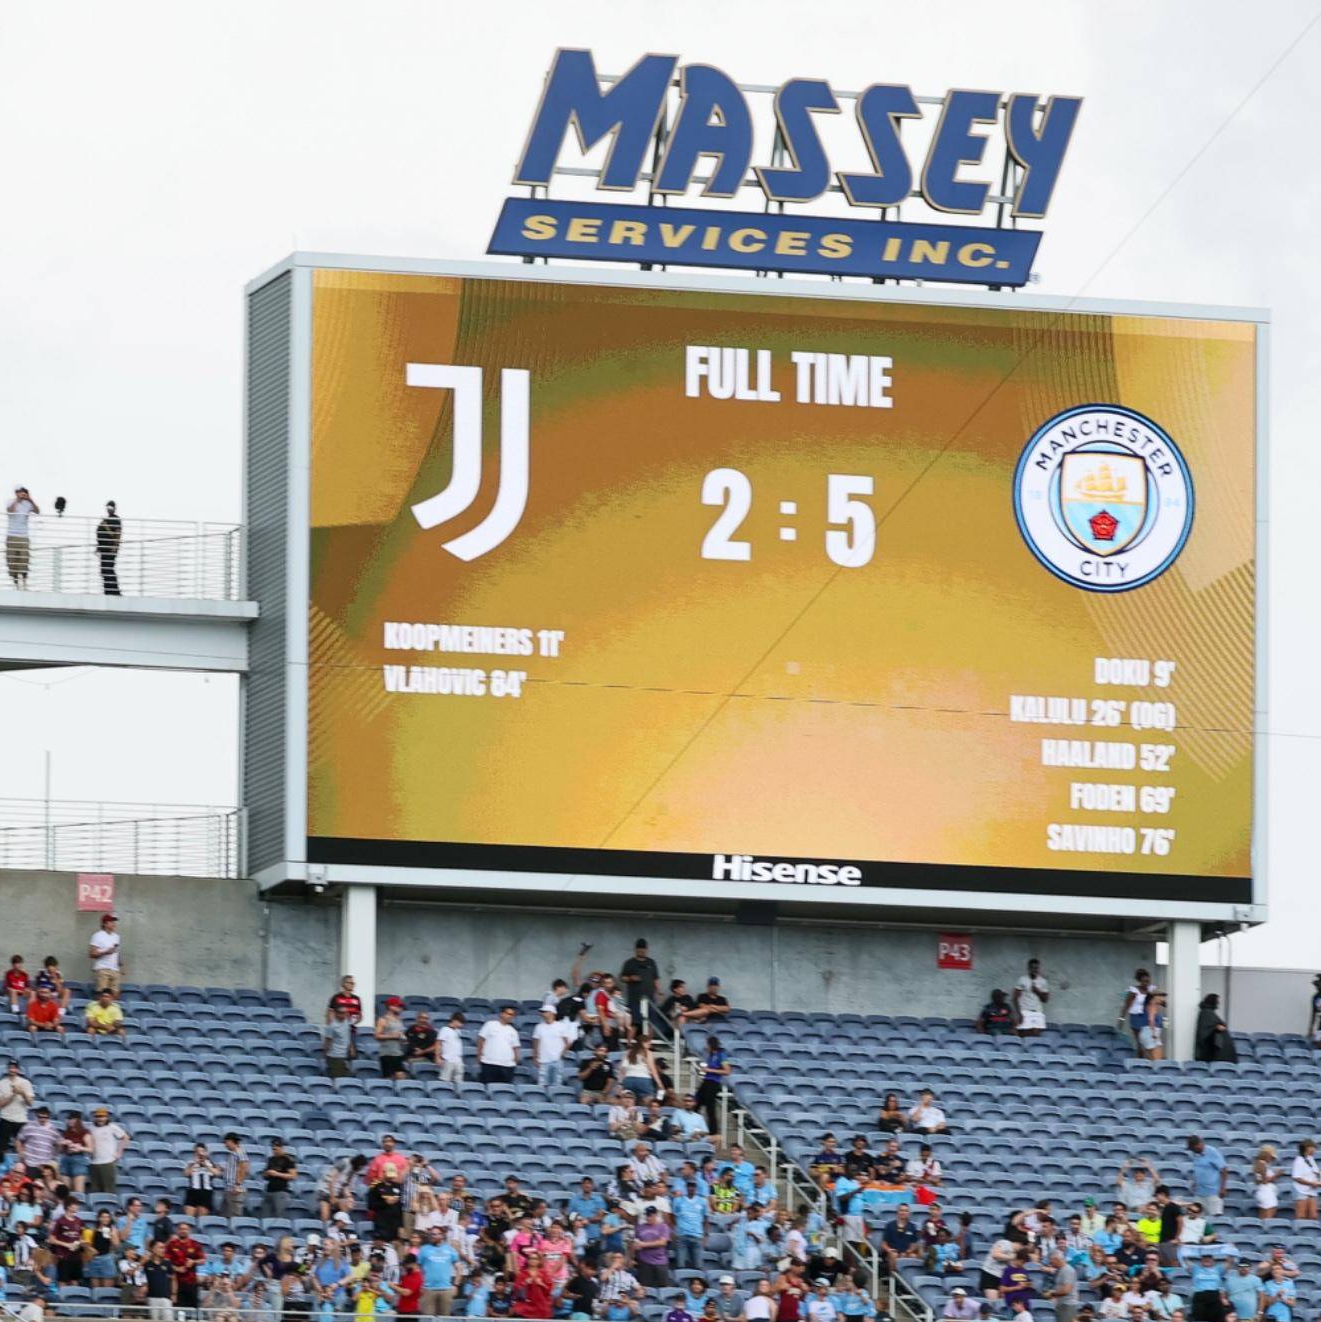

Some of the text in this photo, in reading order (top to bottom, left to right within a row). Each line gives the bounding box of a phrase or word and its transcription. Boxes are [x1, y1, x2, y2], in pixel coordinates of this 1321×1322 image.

[512, 47, 1084, 219] MASSEY
[520, 214, 1010, 269] SERVICES INC.
[685, 345, 894, 408] FULL TIME
[1035, 418, 1174, 477] MANCHESTER
[701, 467, 753, 561] 2
[825, 473, 877, 568] 5
[1080, 560, 1129, 578] CITY
[384, 622, 534, 656] KOOPMEINERS
[383, 665, 487, 696] VLAHOVIC
[1094, 657, 1150, 686] DOKU
[1010, 694, 1087, 725] KALULU
[1042, 739, 1136, 770] HAALAND
[1070, 782, 1136, 813] FODEN
[1046, 823, 1136, 855] SAVINHO
[712, 854, 863, 887] Hisense
[79, 884, 112, 902] P42
[939, 942, 971, 961] P43
